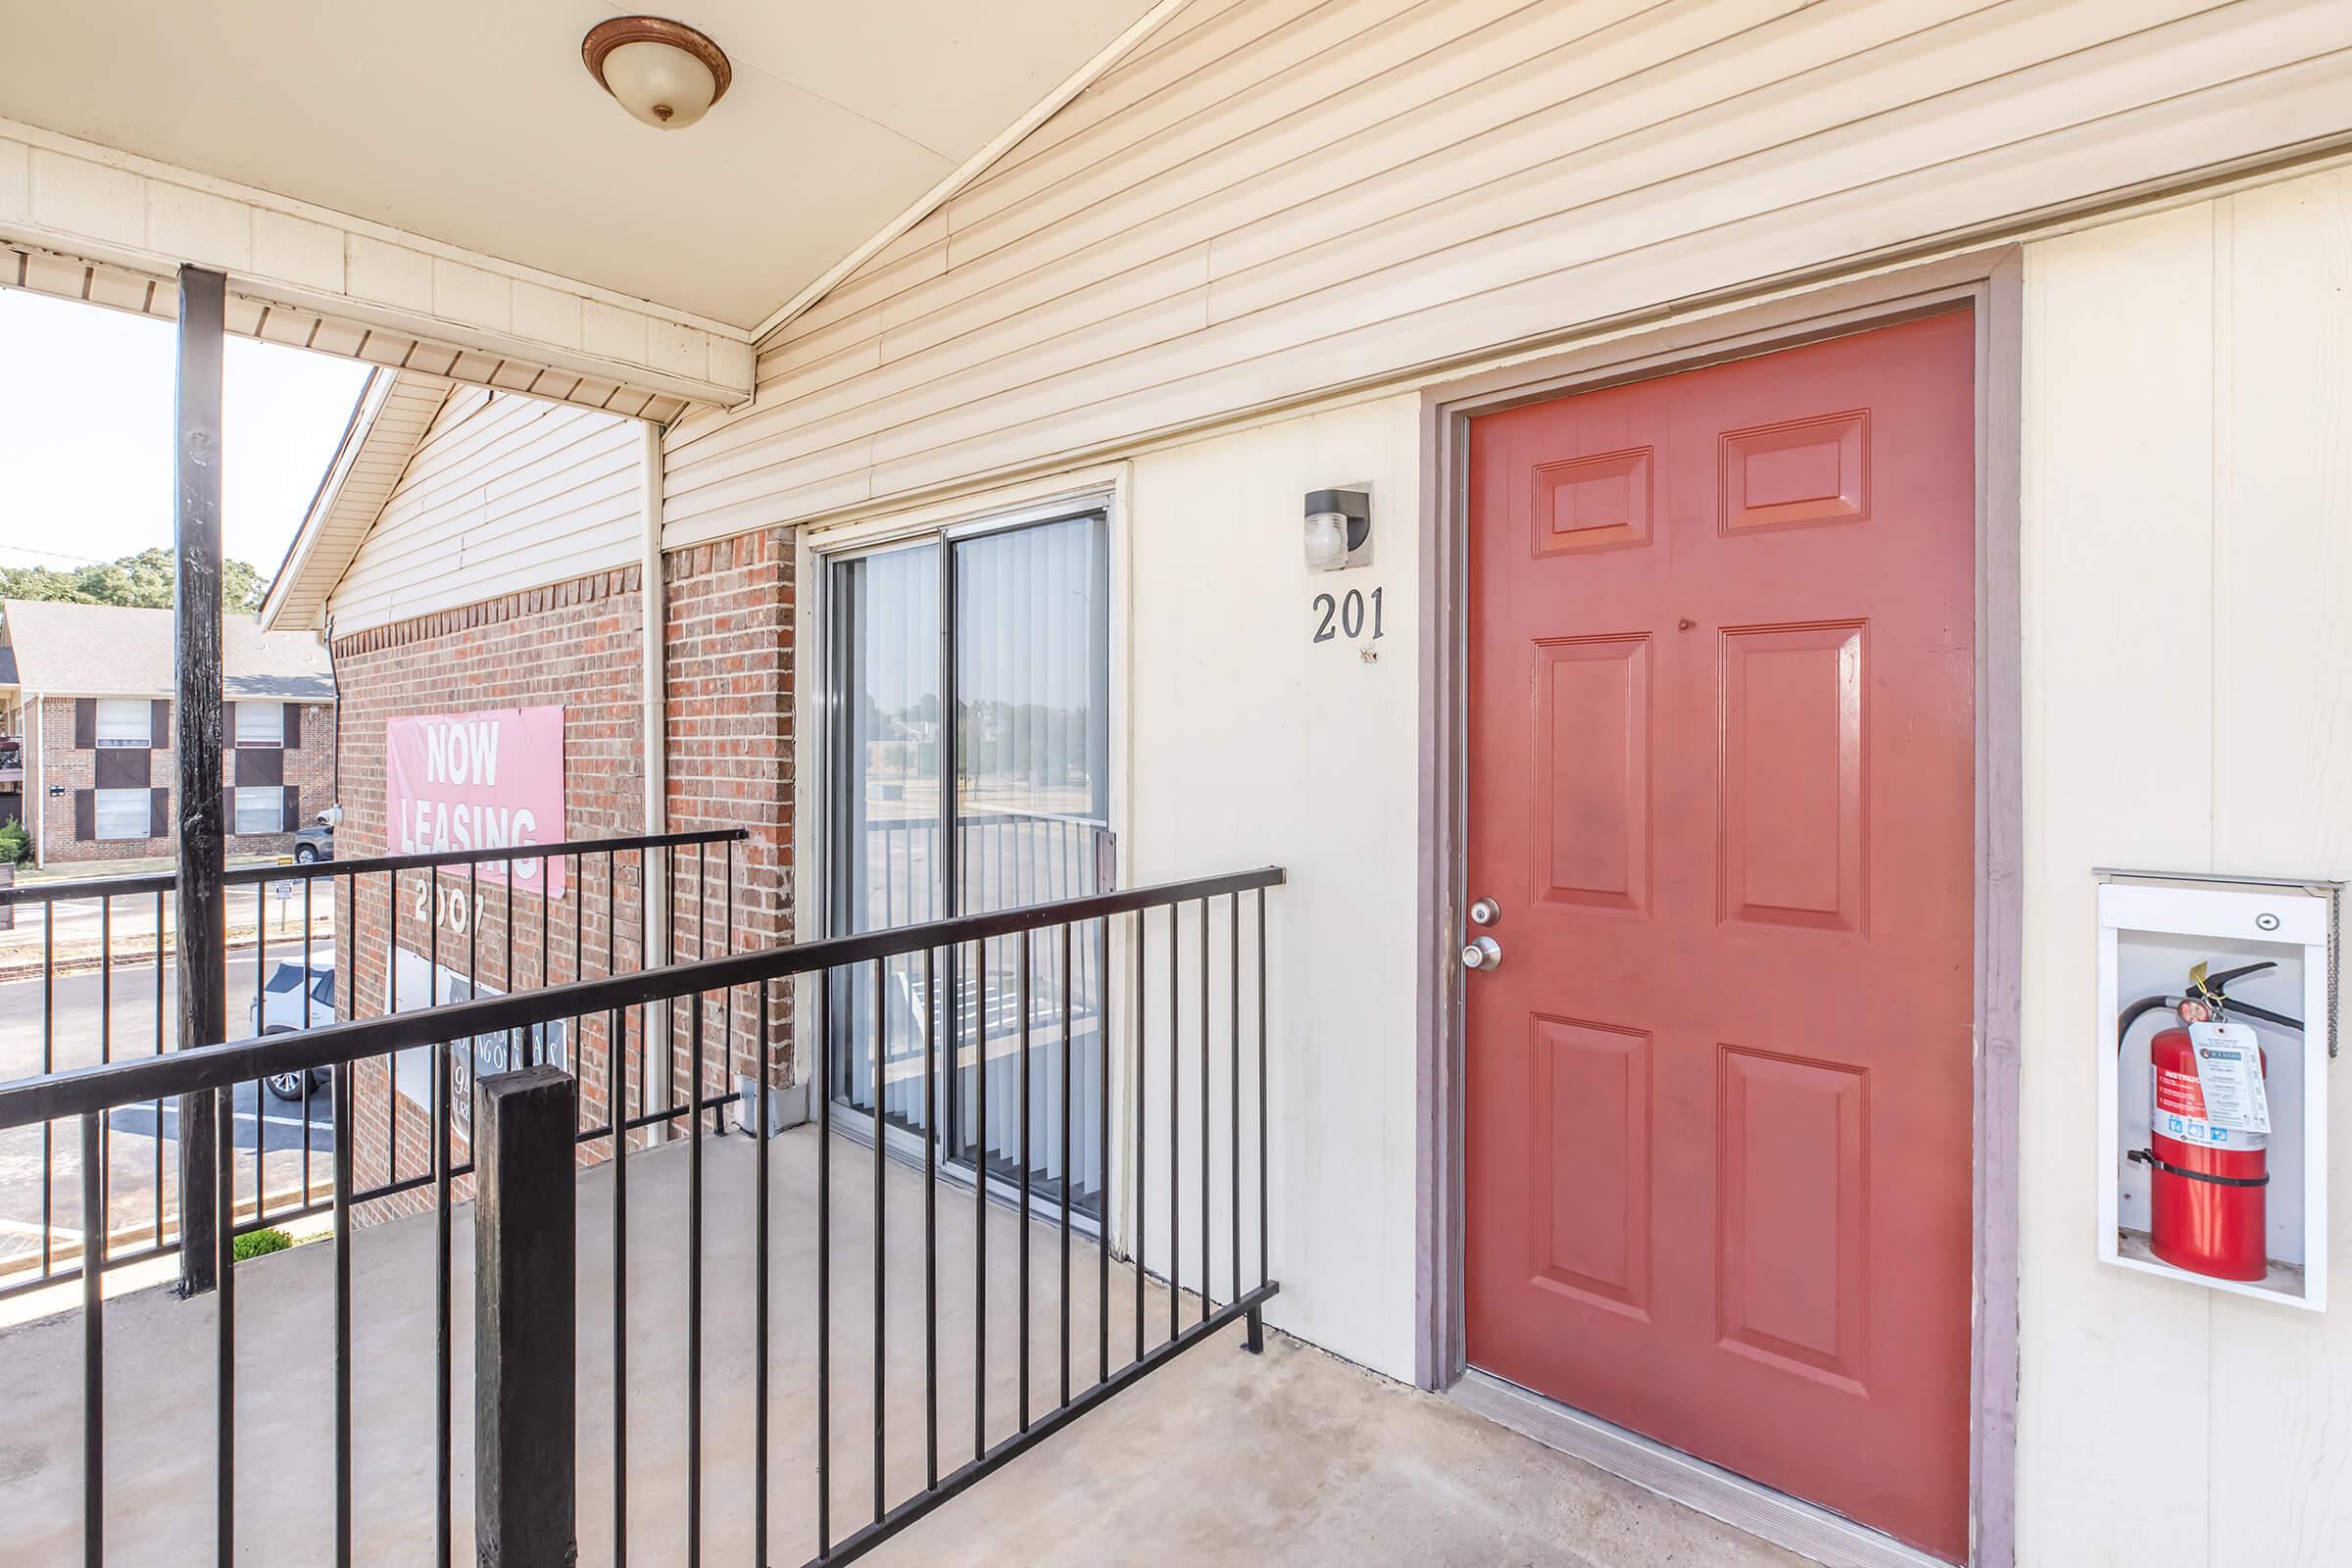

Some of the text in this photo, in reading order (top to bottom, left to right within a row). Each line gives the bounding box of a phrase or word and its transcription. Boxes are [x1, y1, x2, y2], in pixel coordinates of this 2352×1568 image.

[1313, 586, 1384, 643] 201
[427, 720, 500, 786] NOW
[401, 798, 537, 880] LEASING
